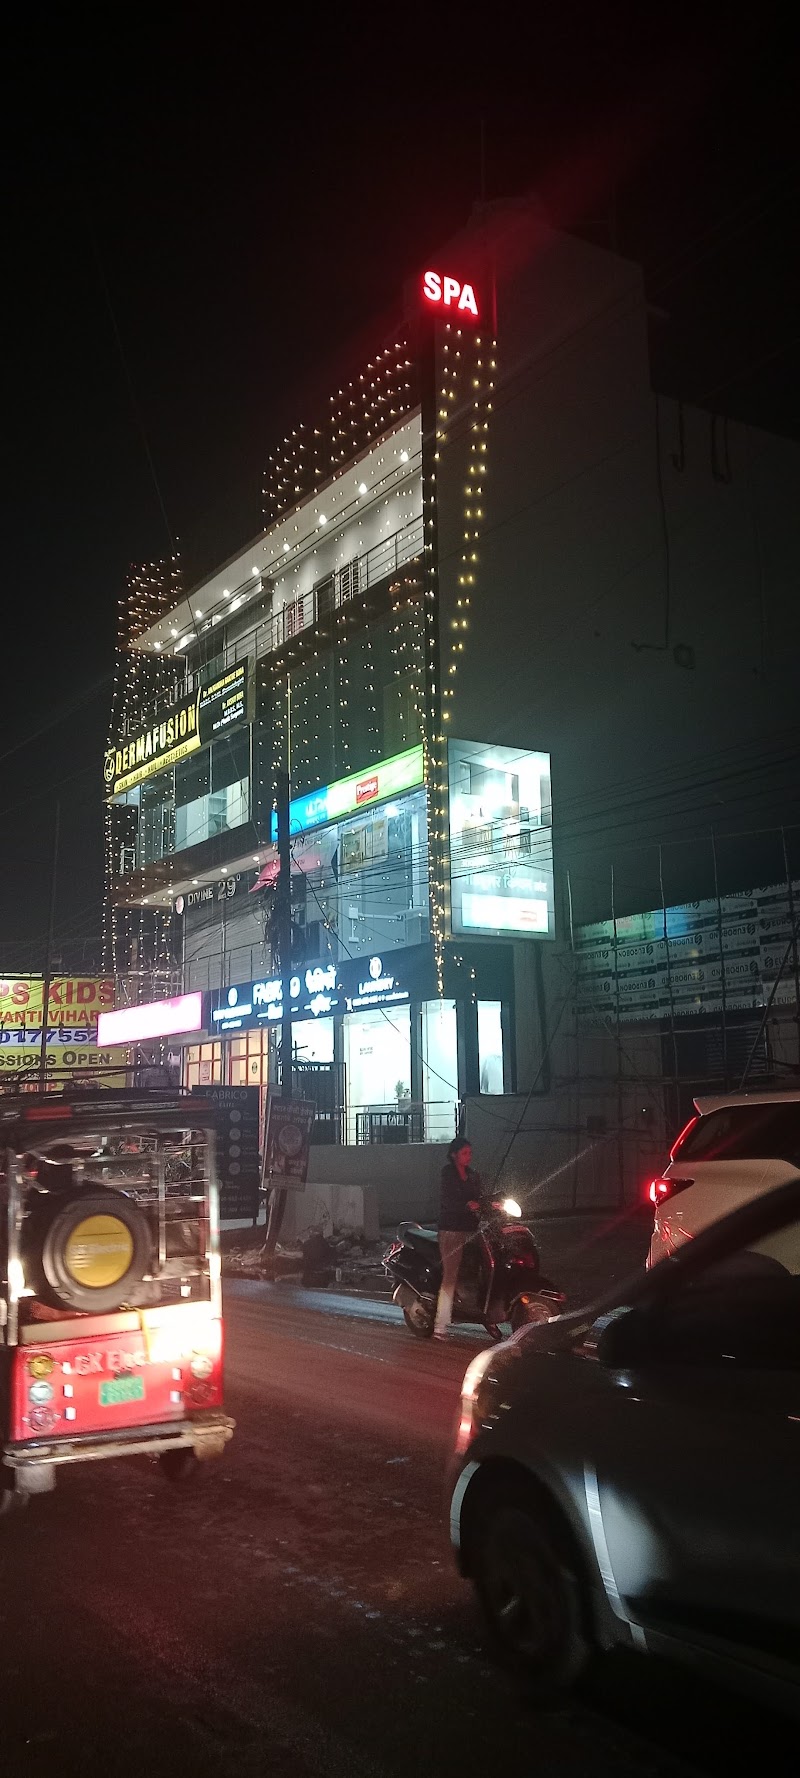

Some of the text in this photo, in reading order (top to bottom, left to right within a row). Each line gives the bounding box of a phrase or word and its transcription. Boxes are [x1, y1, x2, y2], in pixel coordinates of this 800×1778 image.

[423, 271, 479, 316] SPA
[115, 703, 196, 775] DERMAFUSION
[187, 887, 214, 906] DIVINE
[42, 981, 115, 1006] KIDS
[205, 1089, 248, 1101] FABRICO
